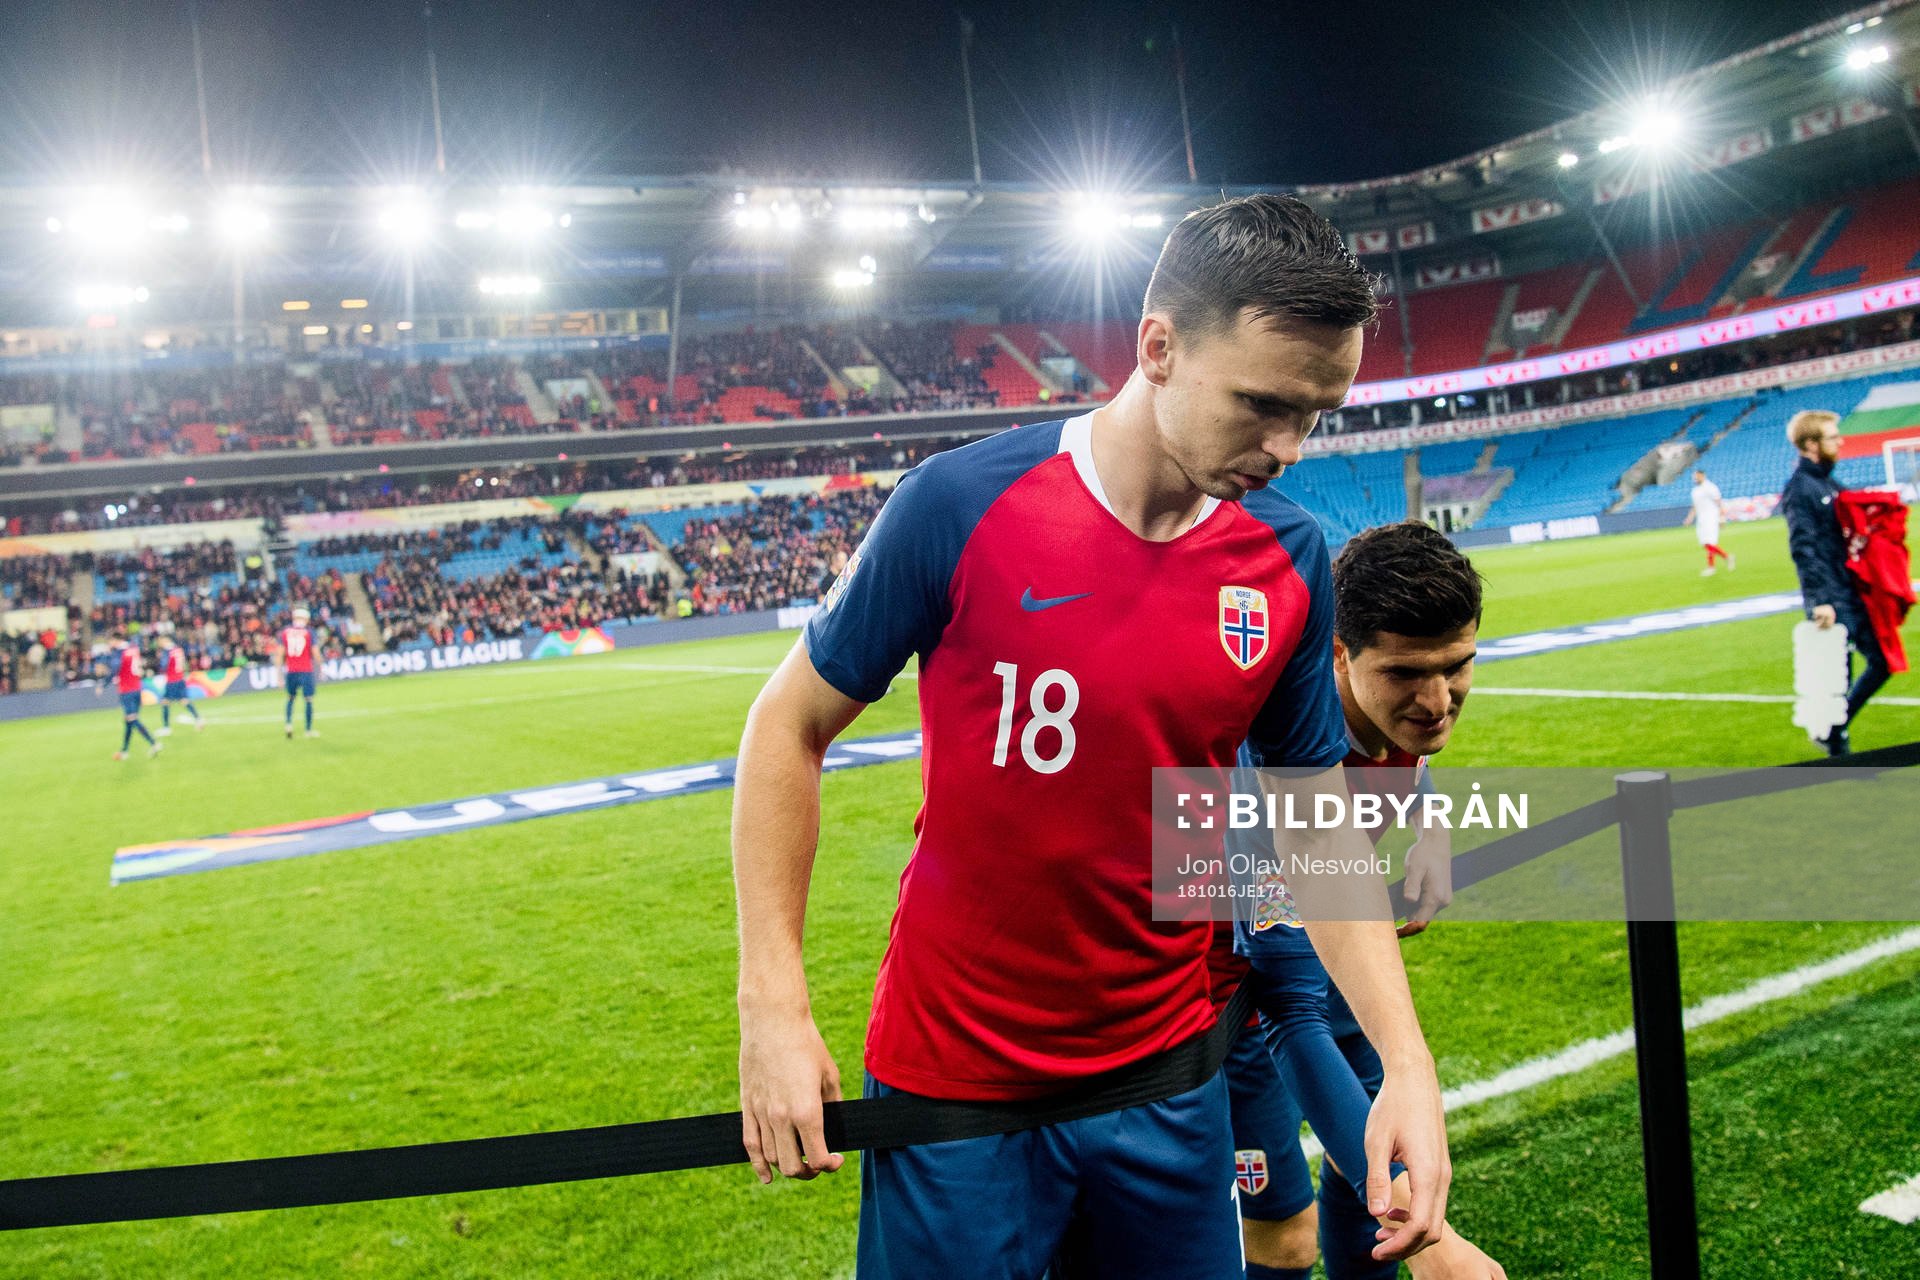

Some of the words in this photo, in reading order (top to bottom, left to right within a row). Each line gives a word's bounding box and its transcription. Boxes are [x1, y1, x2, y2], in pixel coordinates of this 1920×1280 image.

[1407, 373, 1462, 398] VG
[1485, 361, 1540, 387] VG
[1561, 349, 1611, 374] VG
[1628, 331, 1680, 360] VG
[1700, 317, 1753, 346] VG
[1776, 299, 1836, 330] VG
[321, 650, 427, 681] NATIONS
[431, 639, 524, 669] LEAGUE
[993, 661, 1080, 774] 18
